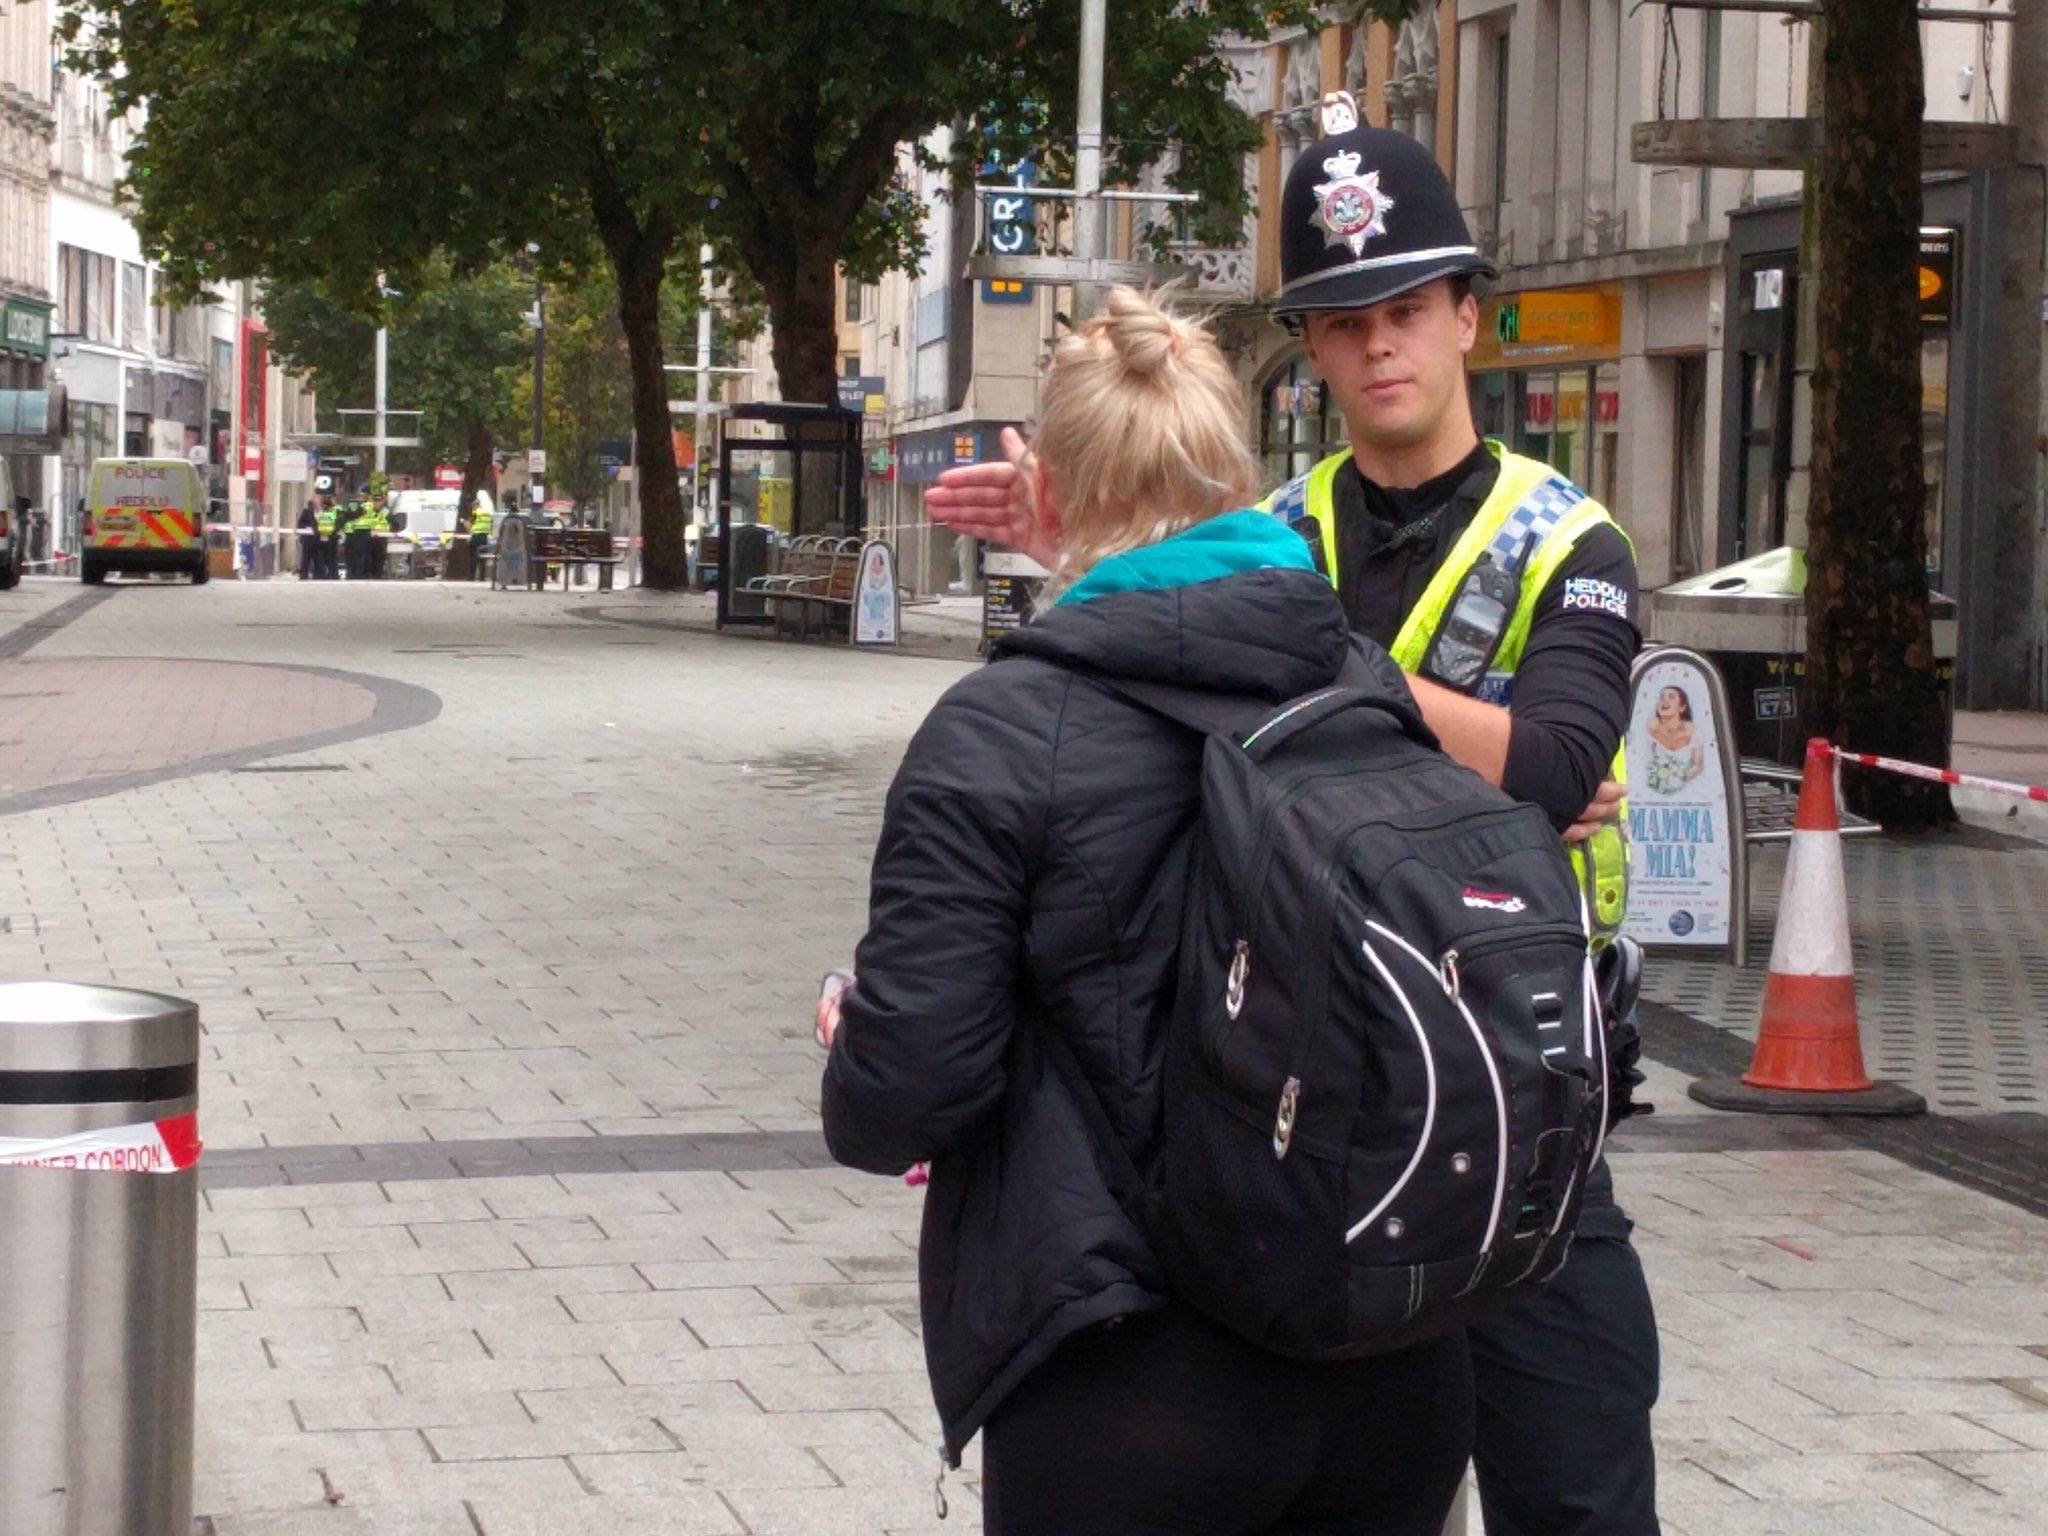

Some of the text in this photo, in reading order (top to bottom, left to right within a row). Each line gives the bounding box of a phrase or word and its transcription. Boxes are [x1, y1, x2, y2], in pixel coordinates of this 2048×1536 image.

[115, 467, 166, 480] POLICE
[115, 496, 168, 507] HEDDLU
[1564, 577, 1627, 605] HEDDLU
[1562, 593, 1627, 619] POLICE
[1629, 808, 1714, 843] MAMMA
[1645, 844, 1696, 878] MIA!
[84, 1144, 161, 1173] CORDON
